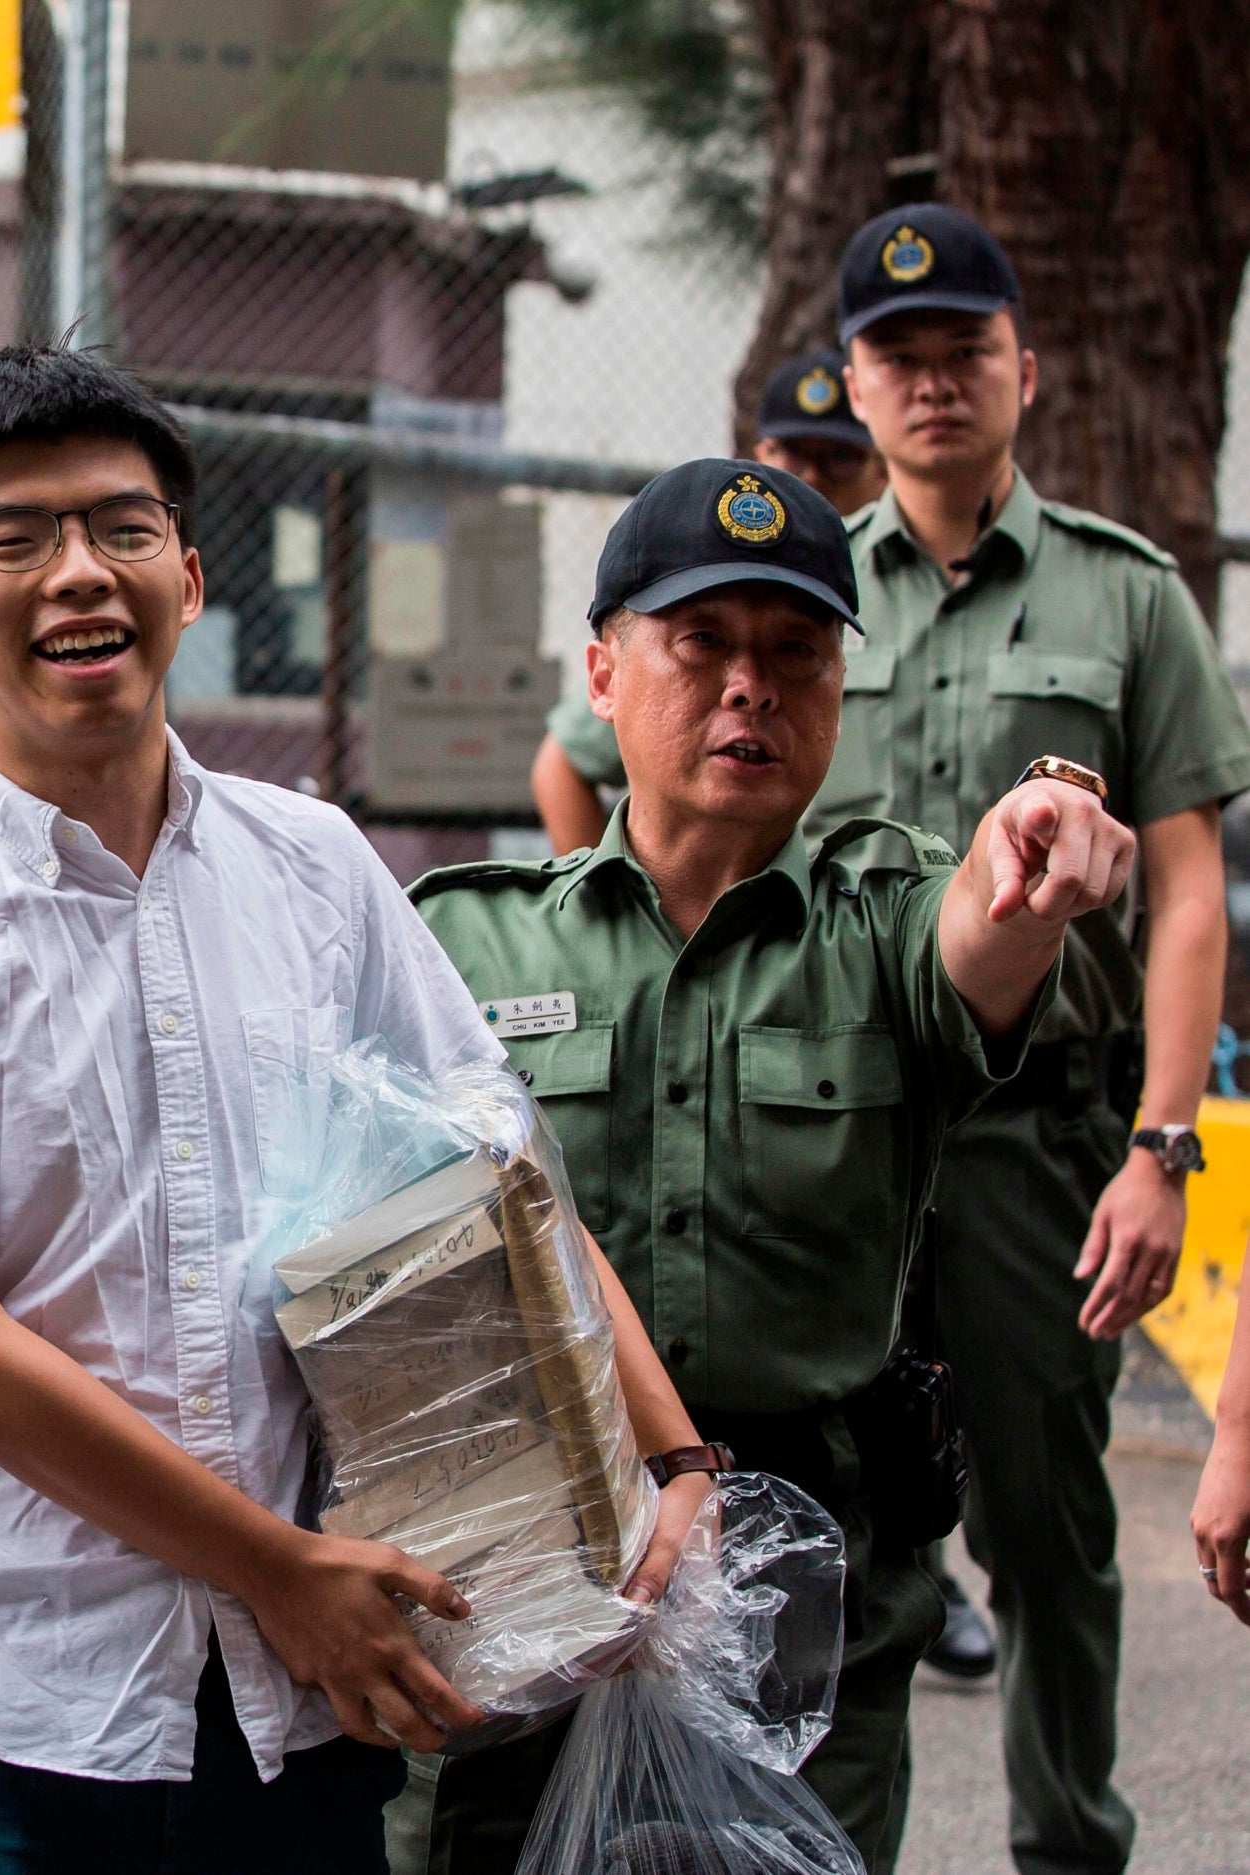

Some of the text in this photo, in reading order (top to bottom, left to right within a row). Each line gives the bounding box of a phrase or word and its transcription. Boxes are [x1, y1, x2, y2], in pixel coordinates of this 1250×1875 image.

[512, 1018, 565, 1031] CHU KIM YEE
